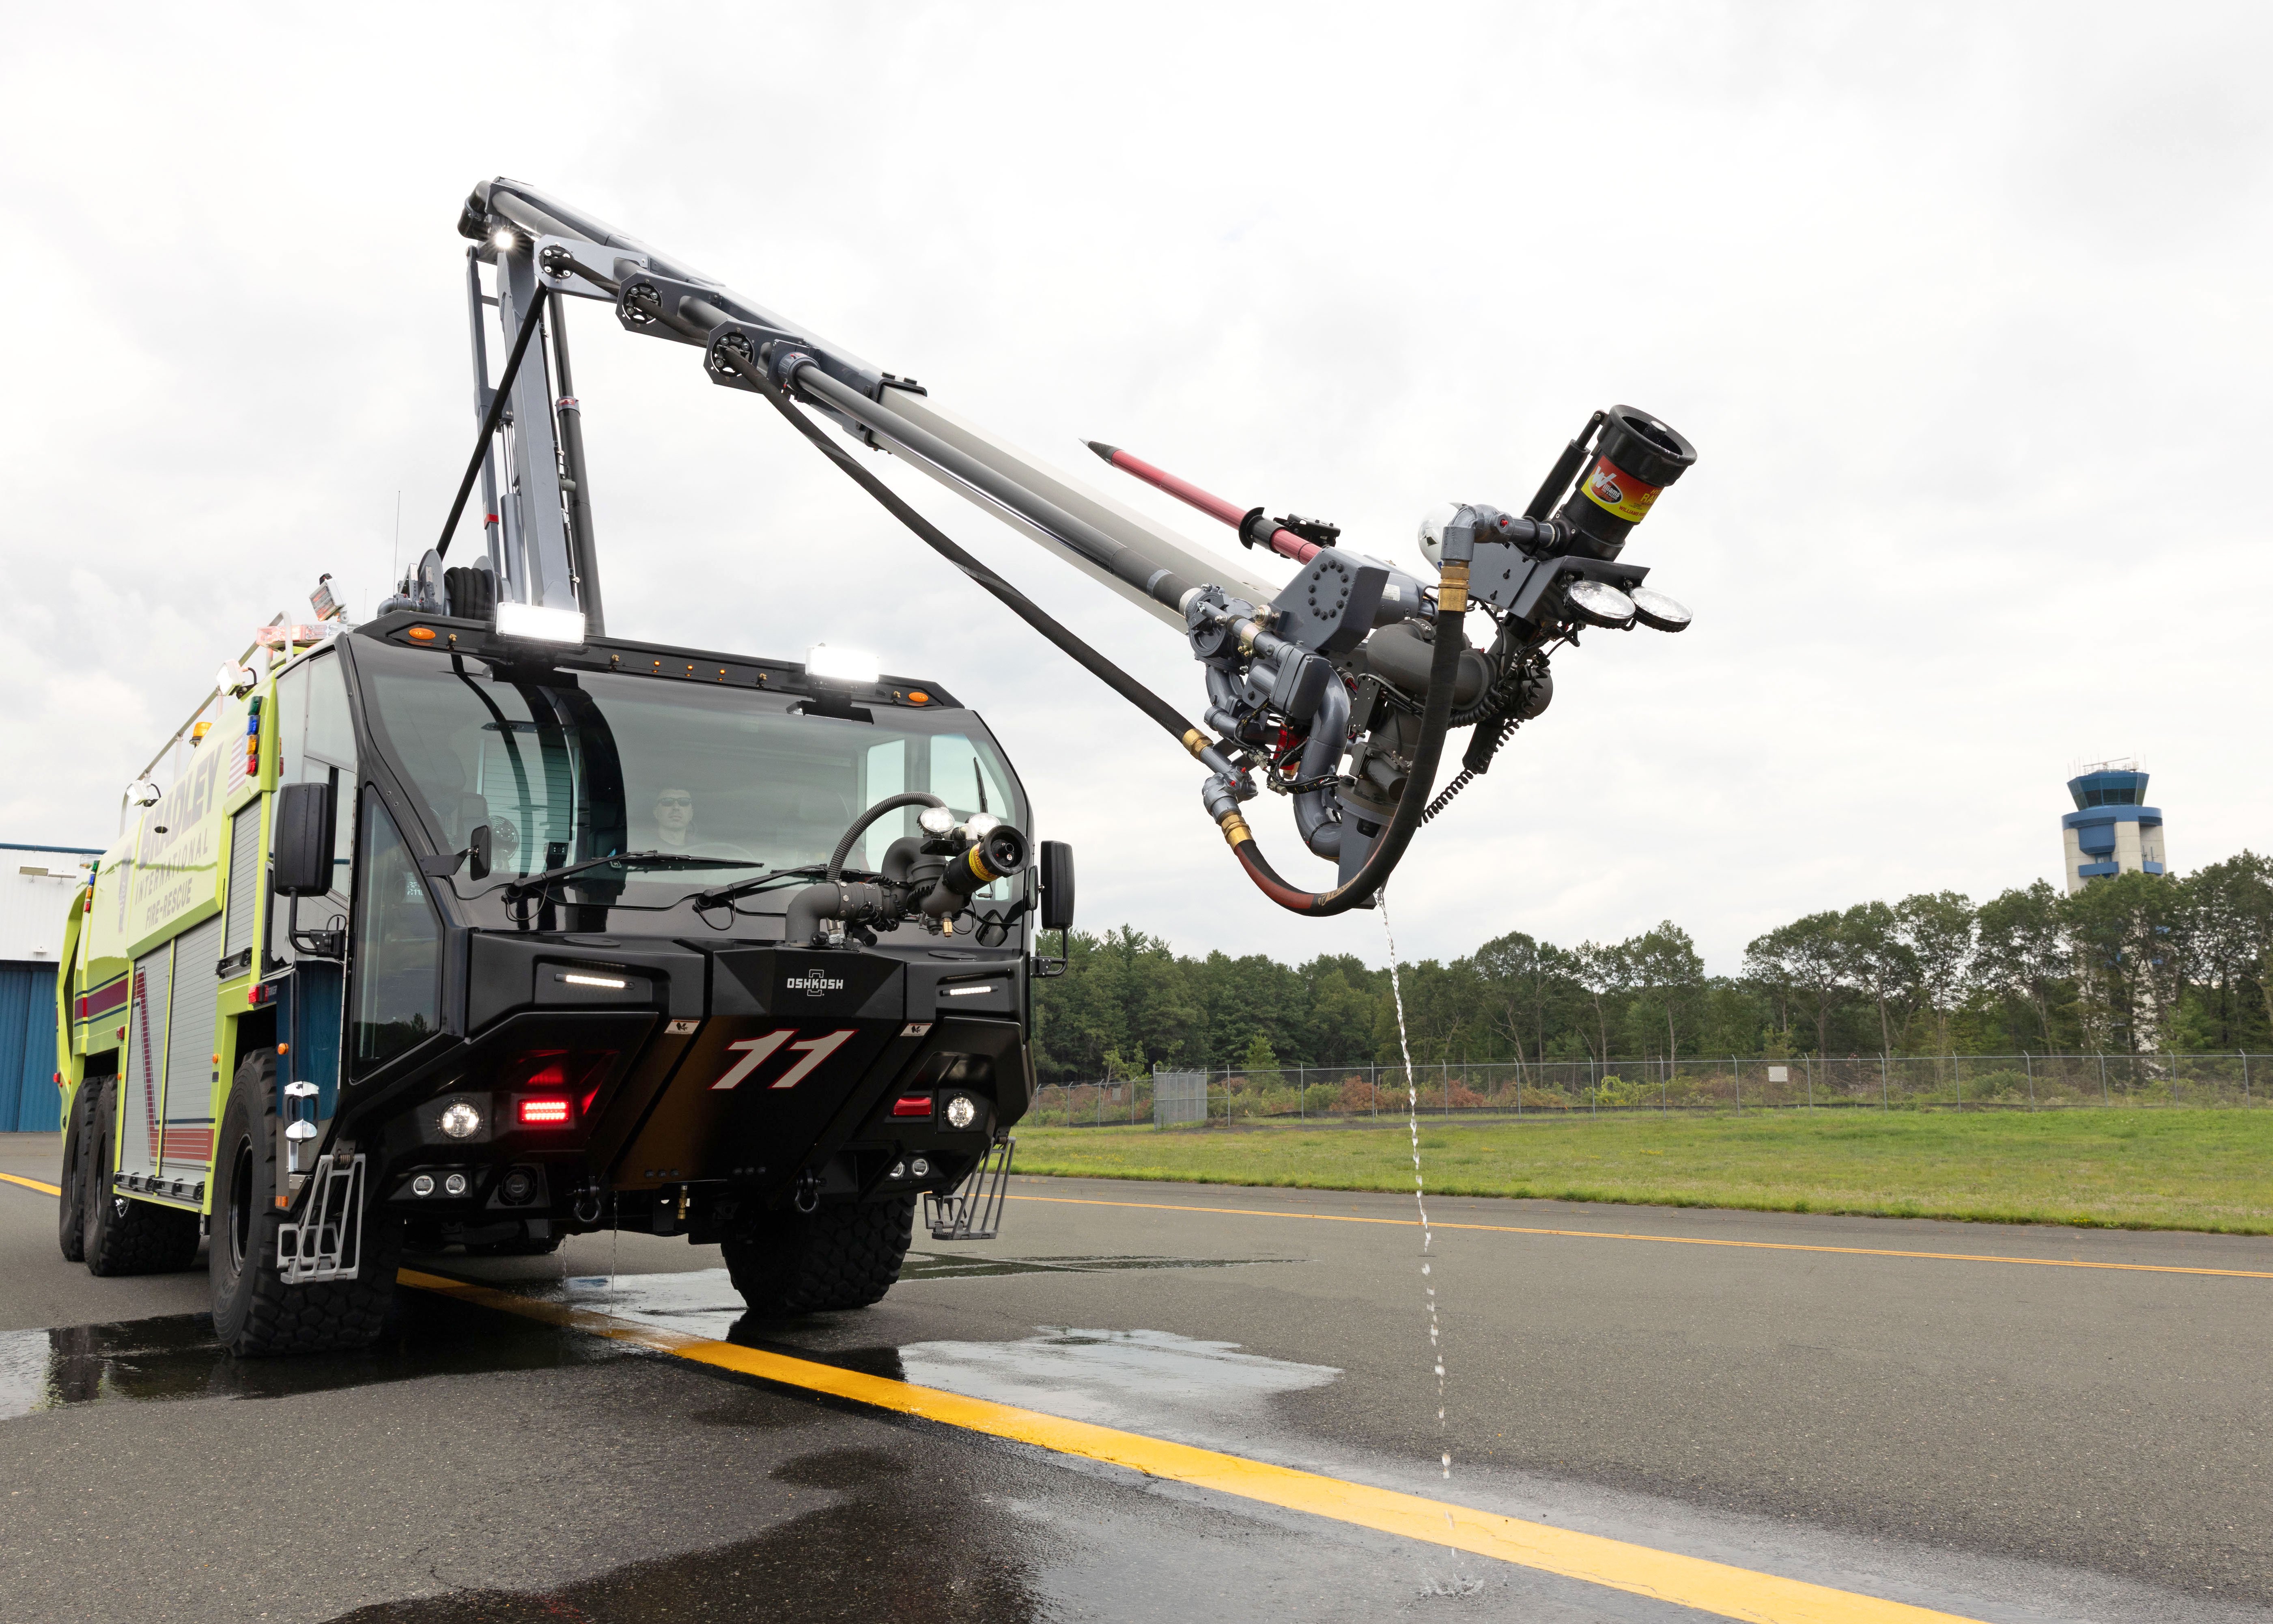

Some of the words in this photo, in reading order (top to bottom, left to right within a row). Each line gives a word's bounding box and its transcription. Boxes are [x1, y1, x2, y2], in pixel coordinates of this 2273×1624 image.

[1619, 505, 1639, 516] WILLIAMS
[139, 741, 224, 871] BRADLEY
[135, 827, 208, 906] INTERNATIONAL
[145, 877, 192, 930] FIRE-RESCUE
[787, 978, 844, 989] OSHKOSH
[707, 1028, 860, 1090] 11
